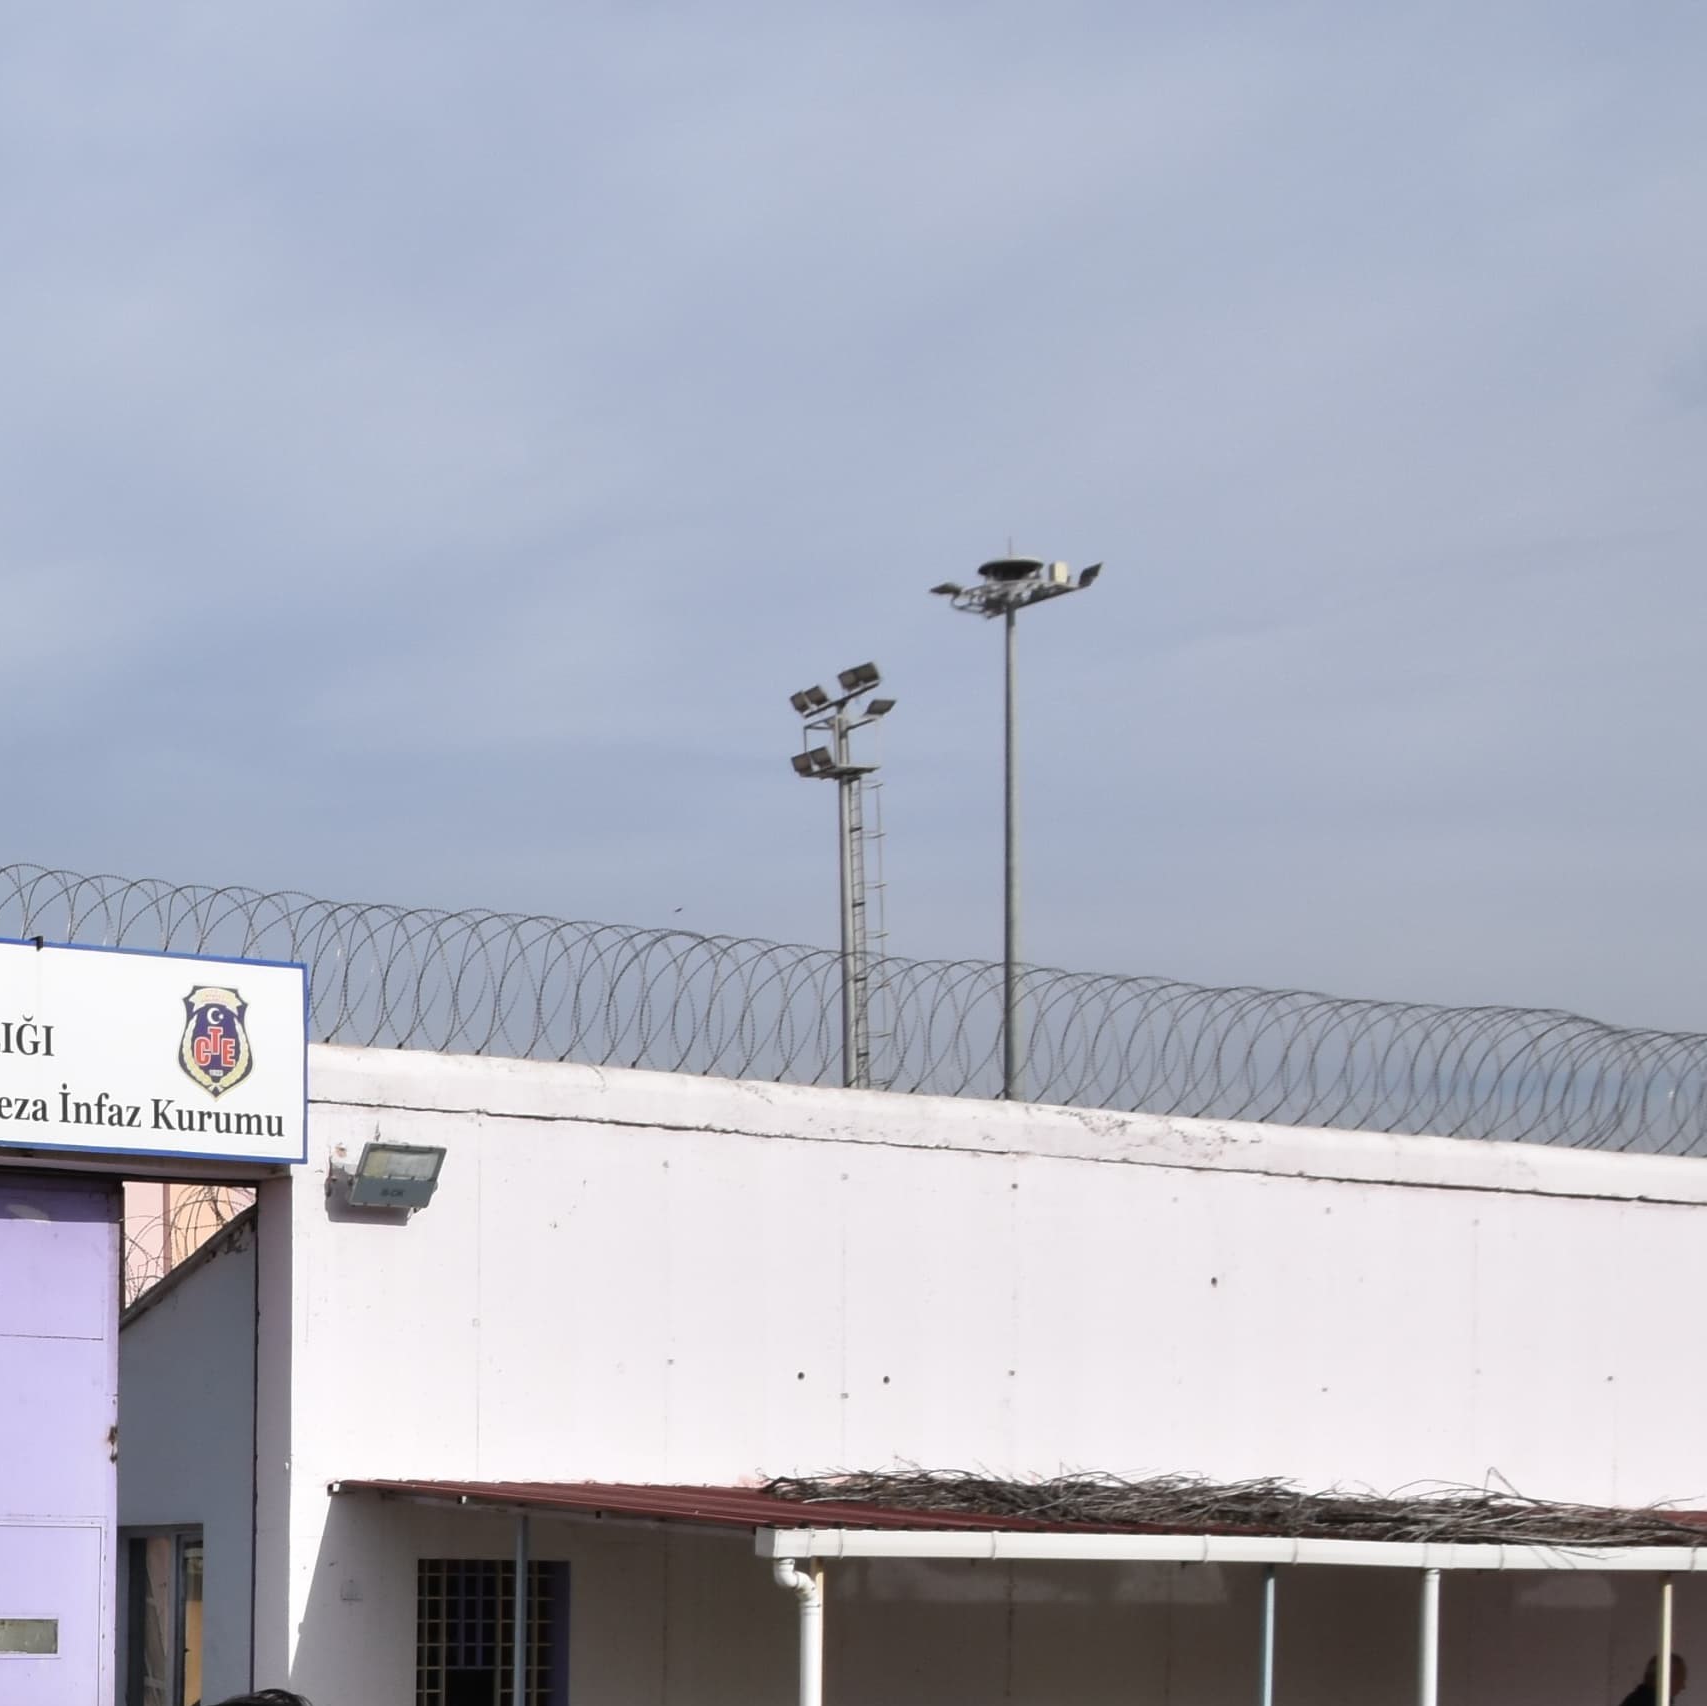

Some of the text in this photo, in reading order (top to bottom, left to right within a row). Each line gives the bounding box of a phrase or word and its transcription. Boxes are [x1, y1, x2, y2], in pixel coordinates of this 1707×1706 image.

[194, 1026, 236, 1067] CTE
[59, 1083, 142, 1128] İnfaz
[150, 1098, 285, 1137] Kurumu
